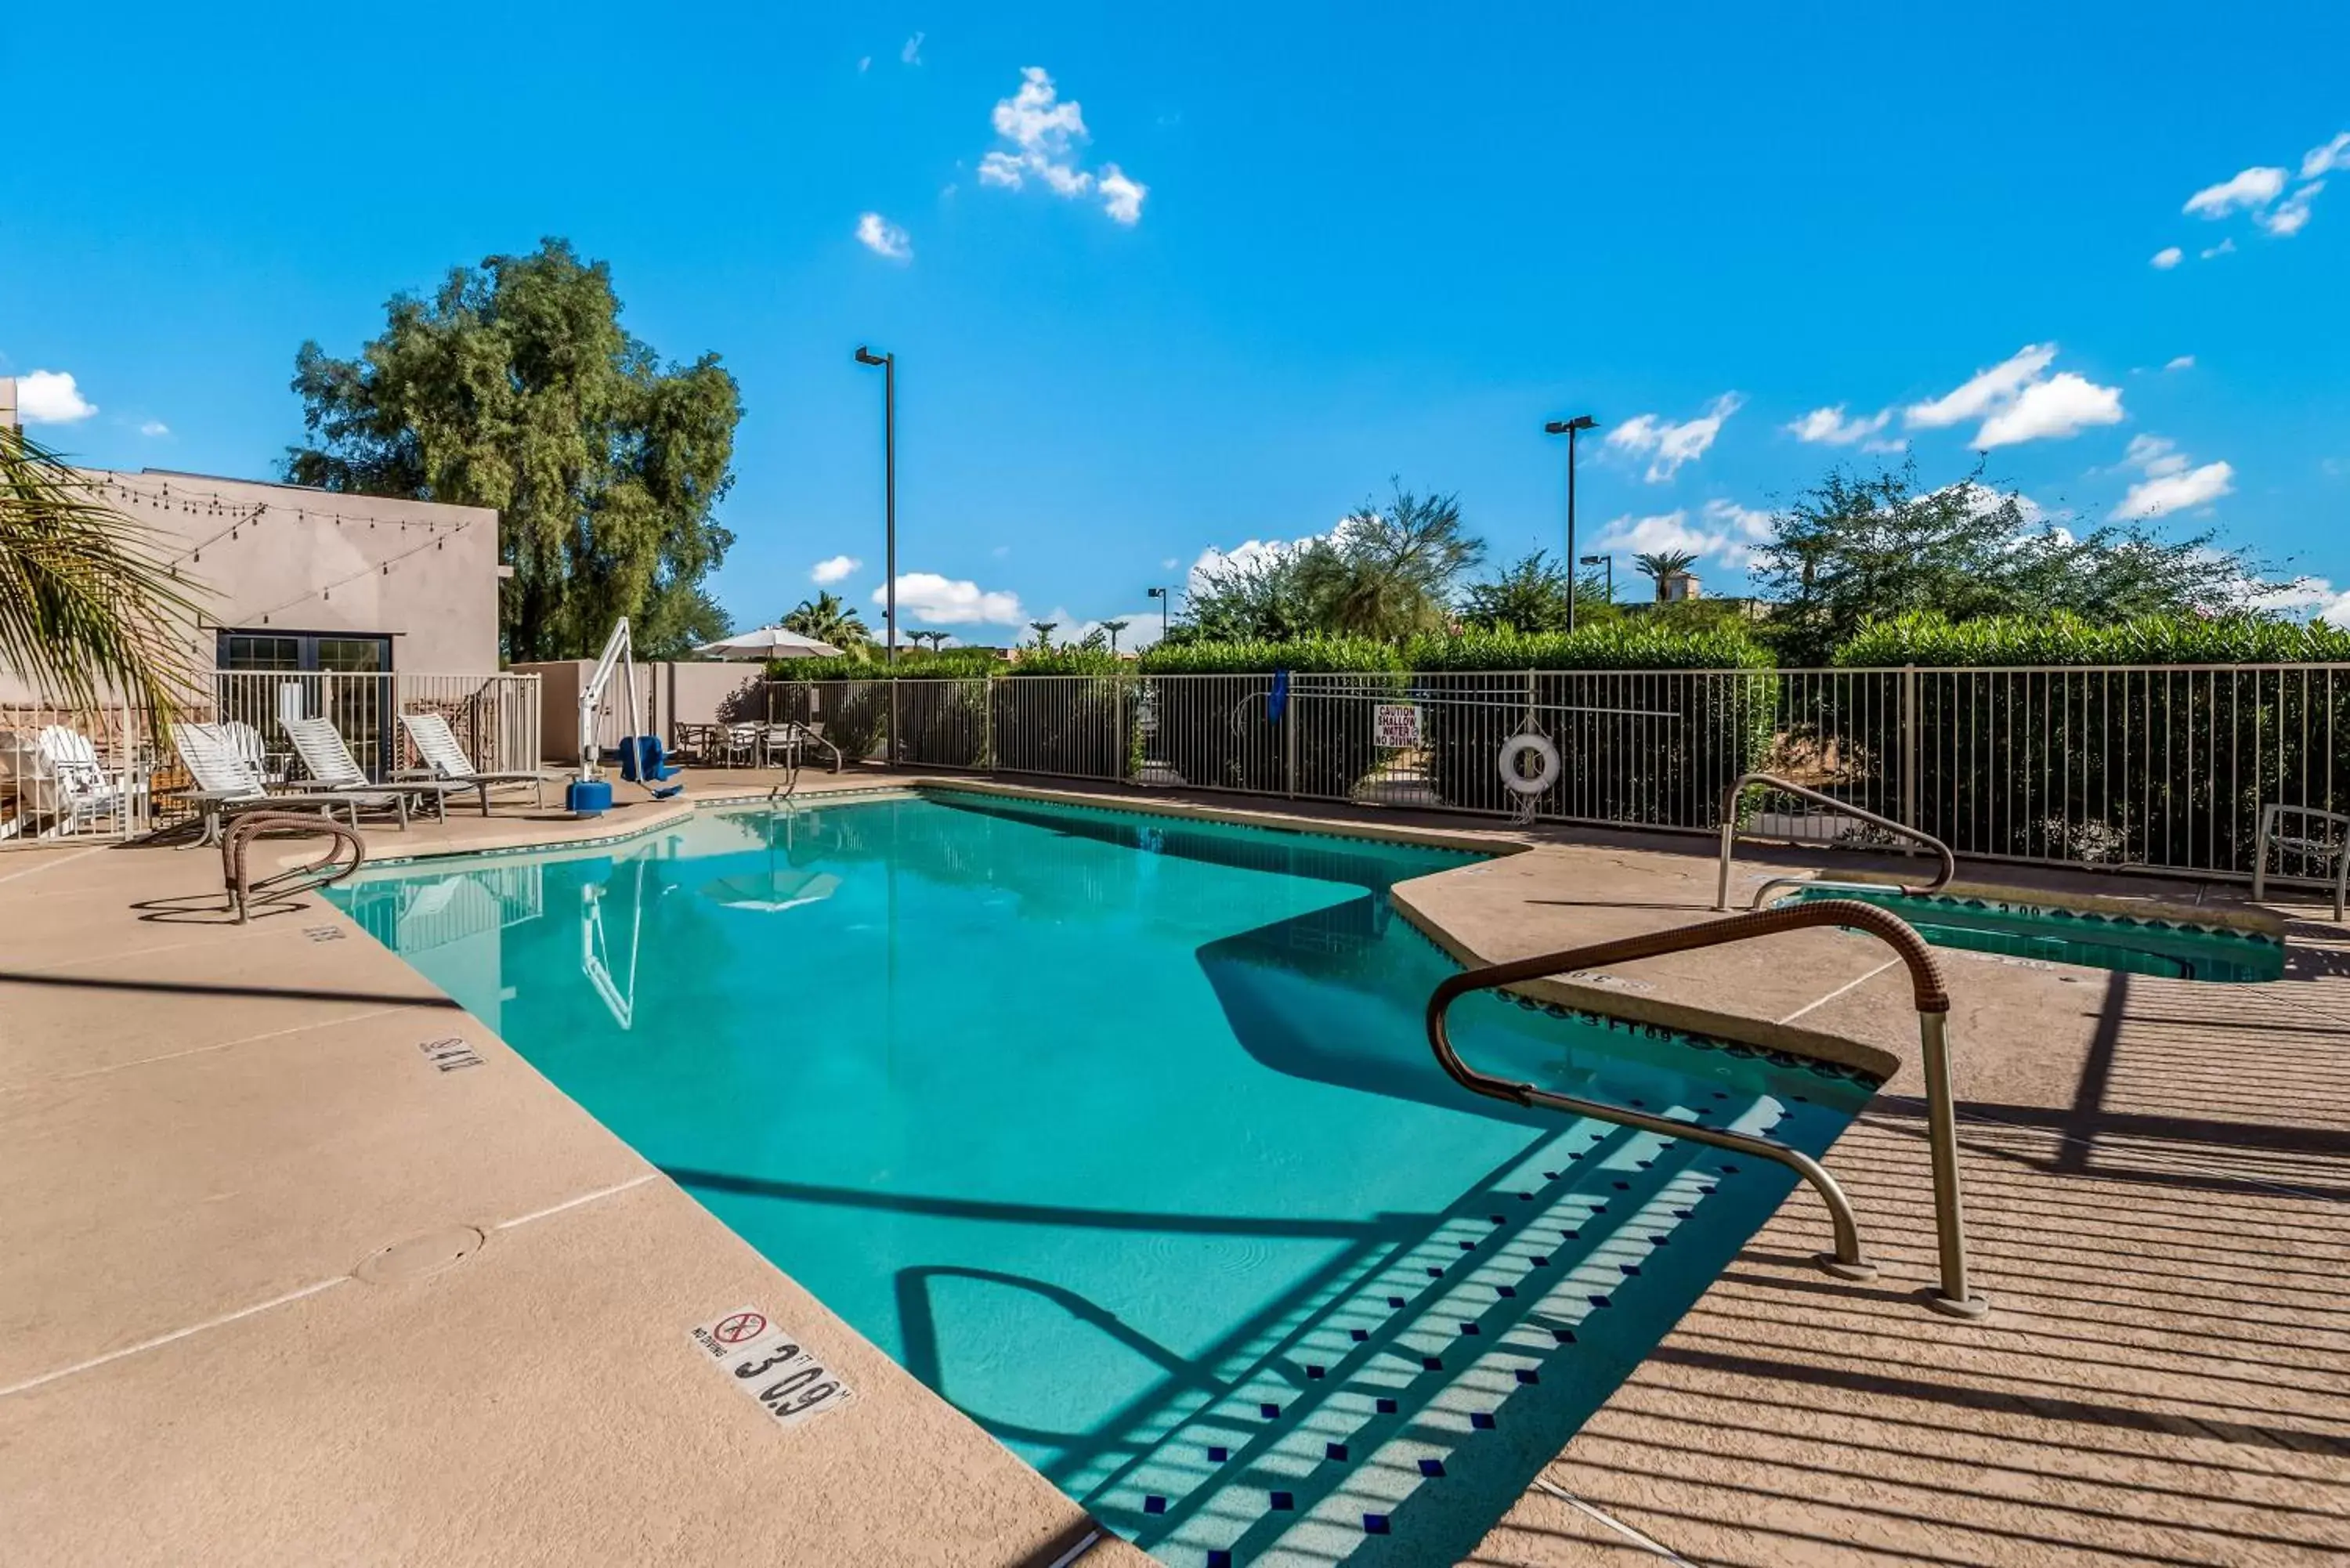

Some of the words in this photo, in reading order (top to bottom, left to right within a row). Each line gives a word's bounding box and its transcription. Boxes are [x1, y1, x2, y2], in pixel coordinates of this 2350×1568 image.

[1379, 706, 1415, 717] CAUTION
[1379, 716, 1416, 727] SHALLOW
[1383, 726, 1409, 736] WATER
[1376, 735, 1387, 745] NO
[1390, 736, 1418, 749] DIVING
[691, 1328, 707, 1339] NO
[735, 1344, 800, 1379] 3
[759, 1367, 841, 1416] 0.9
